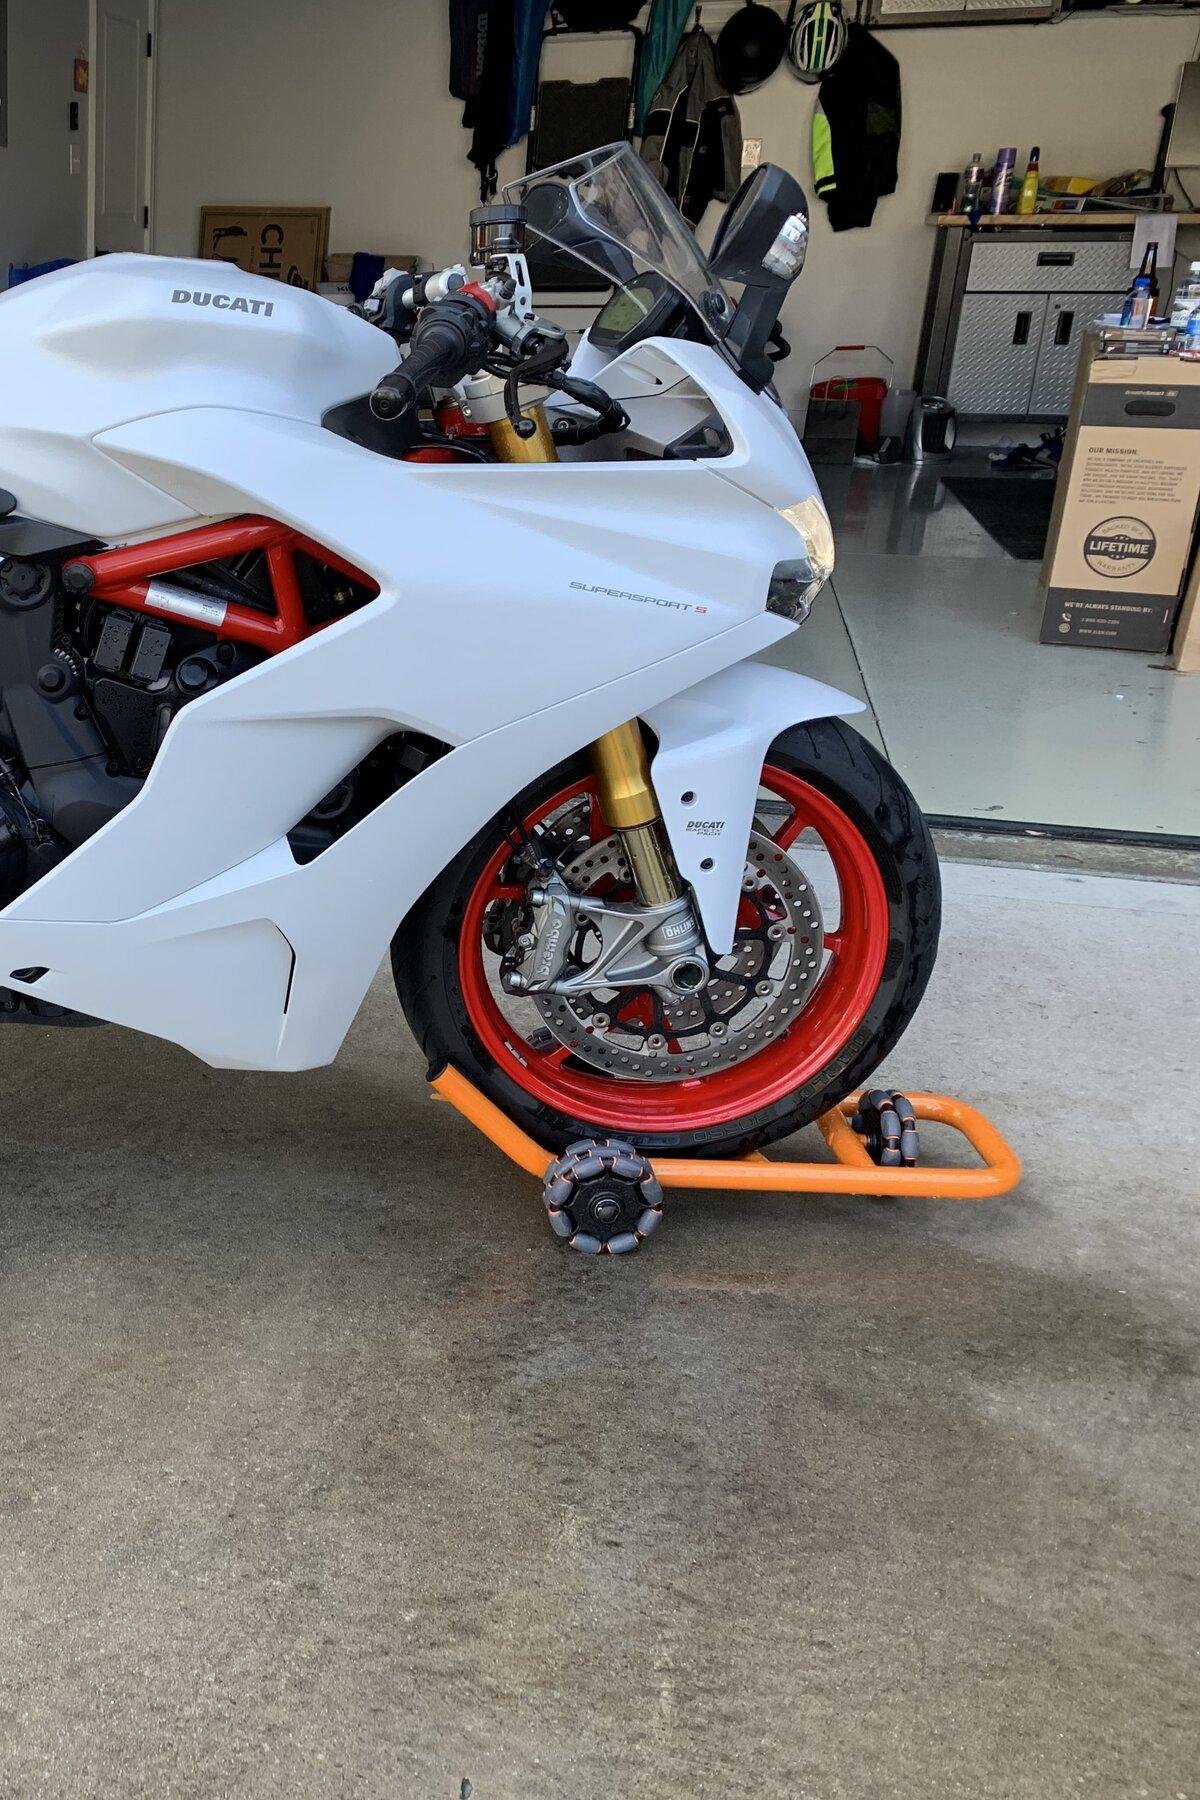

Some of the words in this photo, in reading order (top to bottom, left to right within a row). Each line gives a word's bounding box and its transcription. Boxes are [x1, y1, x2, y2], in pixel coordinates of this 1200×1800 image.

[171, 289, 274, 317] DUCATI
[1106, 447, 1138, 455] MISSION
[1089, 540, 1150, 554] LIFETIME
[569, 581, 692, 611] SUPERSPORT
[694, 606, 708, 614] S
[687, 820, 725, 829] DUCATI
[535, 918, 563, 976] brembo
